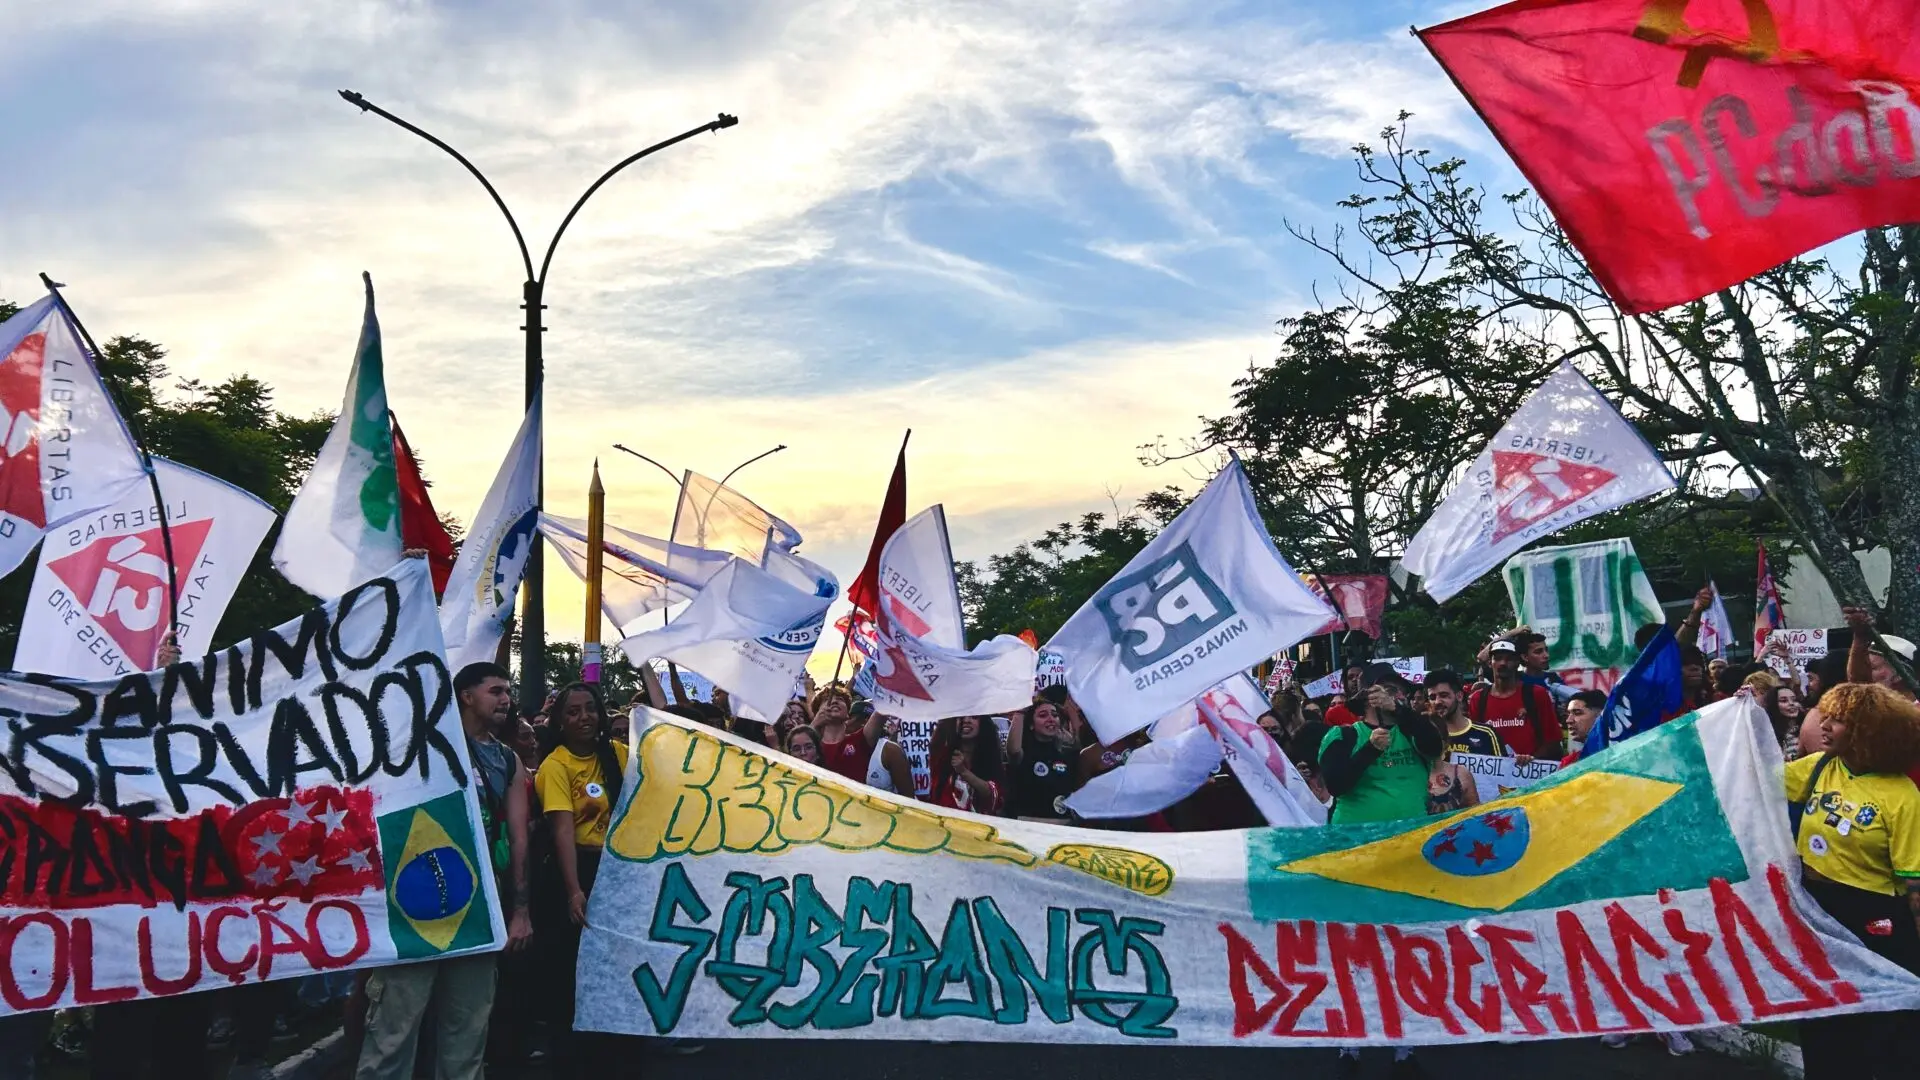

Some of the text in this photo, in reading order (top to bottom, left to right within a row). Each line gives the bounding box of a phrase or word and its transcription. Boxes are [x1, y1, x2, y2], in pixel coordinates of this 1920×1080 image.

[47, 358, 73, 500] LIBERTAS
[1783, 630, 1807, 645] NÃO
[1457, 755, 1504, 777] BRASIL
[0, 899, 371, 1010] OLUÇÃO
